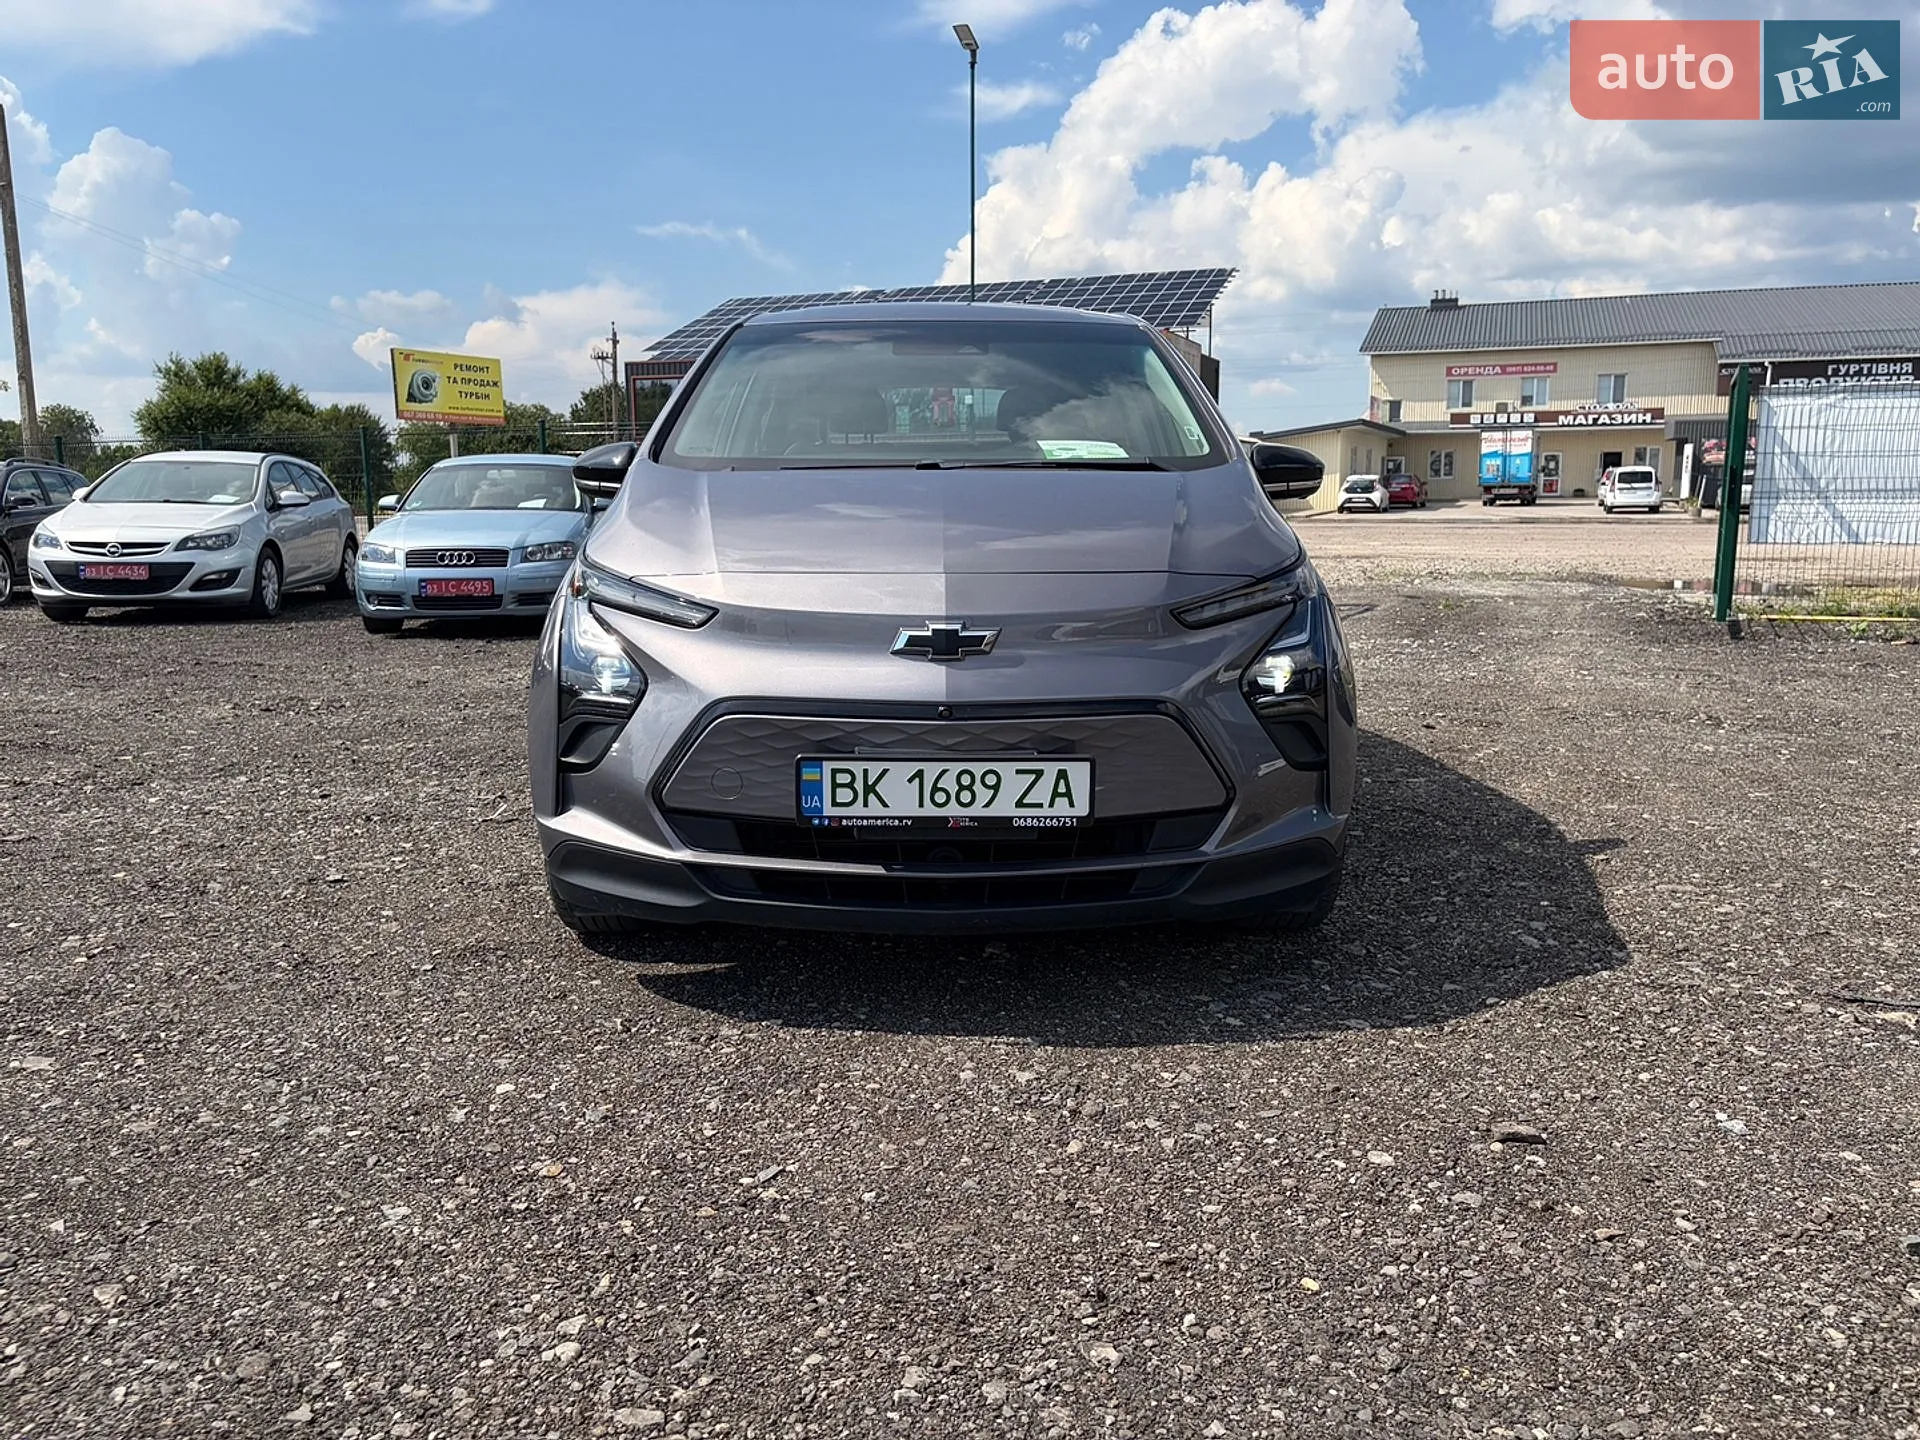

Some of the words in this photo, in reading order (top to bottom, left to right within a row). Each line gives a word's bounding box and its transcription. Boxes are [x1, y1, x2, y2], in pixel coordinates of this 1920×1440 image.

[453, 362, 491, 375] РЕМОНТ
[1451, 366, 1502, 376] ОРЕНДА
[1827, 362, 1913, 376] ГУРТІВНЯ
[446, 375, 460, 385] ТА
[460, 376, 500, 389] ПРОДАЖ
[457, 390, 491, 401] ТУРБІН
[1558, 412, 1652, 426] МАГАЗИН
[85, 567, 97, 577] 03
[118, 565, 146, 577] 4434
[426, 583, 438, 593] 03
[460, 581, 490, 593] 4495
[830, 767, 891, 809] BK
[906, 767, 1003, 809] 1689
[1014, 767, 1076, 809] ZA
[802, 796, 822, 809] UA
[841, 817, 912, 827] autoamerica.rv
[1012, 817, 1078, 827] 0686266751
